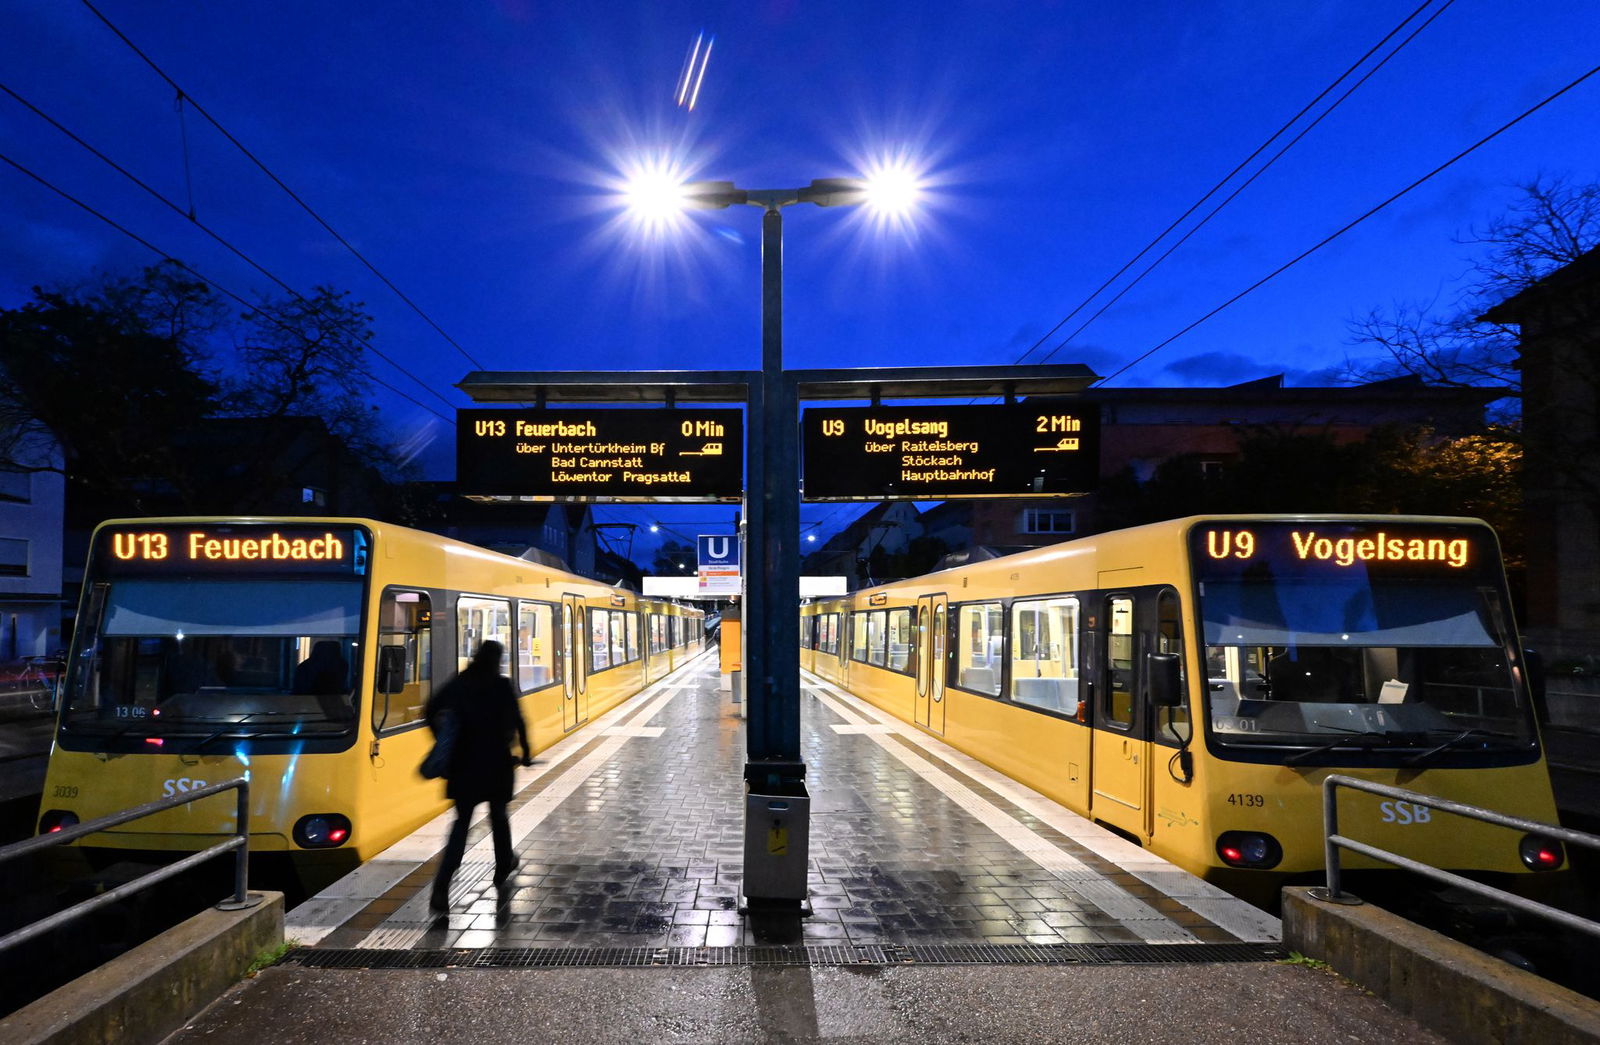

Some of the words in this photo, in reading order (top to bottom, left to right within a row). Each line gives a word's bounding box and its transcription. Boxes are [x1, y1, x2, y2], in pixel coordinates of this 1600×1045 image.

[475, 420, 506, 437] U13
[515, 420, 597, 437] Feuerbach
[696, 420, 724, 437] Min
[822, 419, 844, 436] U9
[865, 418, 948, 438] Vogelsang
[1036, 415, 1048, 432] 2
[1052, 415, 1081, 432] Min
[515, 442, 547, 454] über
[551, 442, 647, 454] Untertürkheim
[651, 442, 666, 457] Bf
[864, 441, 896, 453] über
[901, 440, 979, 454] Raitelsberg
[551, 456, 576, 468] Bad
[580, 456, 644, 468] Cannstatt
[901, 454, 963, 467] Stöckach
[551, 470, 613, 483] Löwentor
[623, 470, 692, 485] Pragsattel
[901, 467, 996, 484] Hauptbahnhof
[113, 532, 169, 560] U13
[188, 531, 344, 561] Feuerbach
[708, 537, 729, 559] U
[1207, 530, 1255, 560] U9
[1291, 531, 1469, 568] Vogelsang
[116, 706, 128, 718] 13
[1240, 719, 1257, 731] 01
[53, 785, 79, 799] 3039
[1227, 793, 1264, 808] 4139
[1380, 800, 1431, 825] SSB
